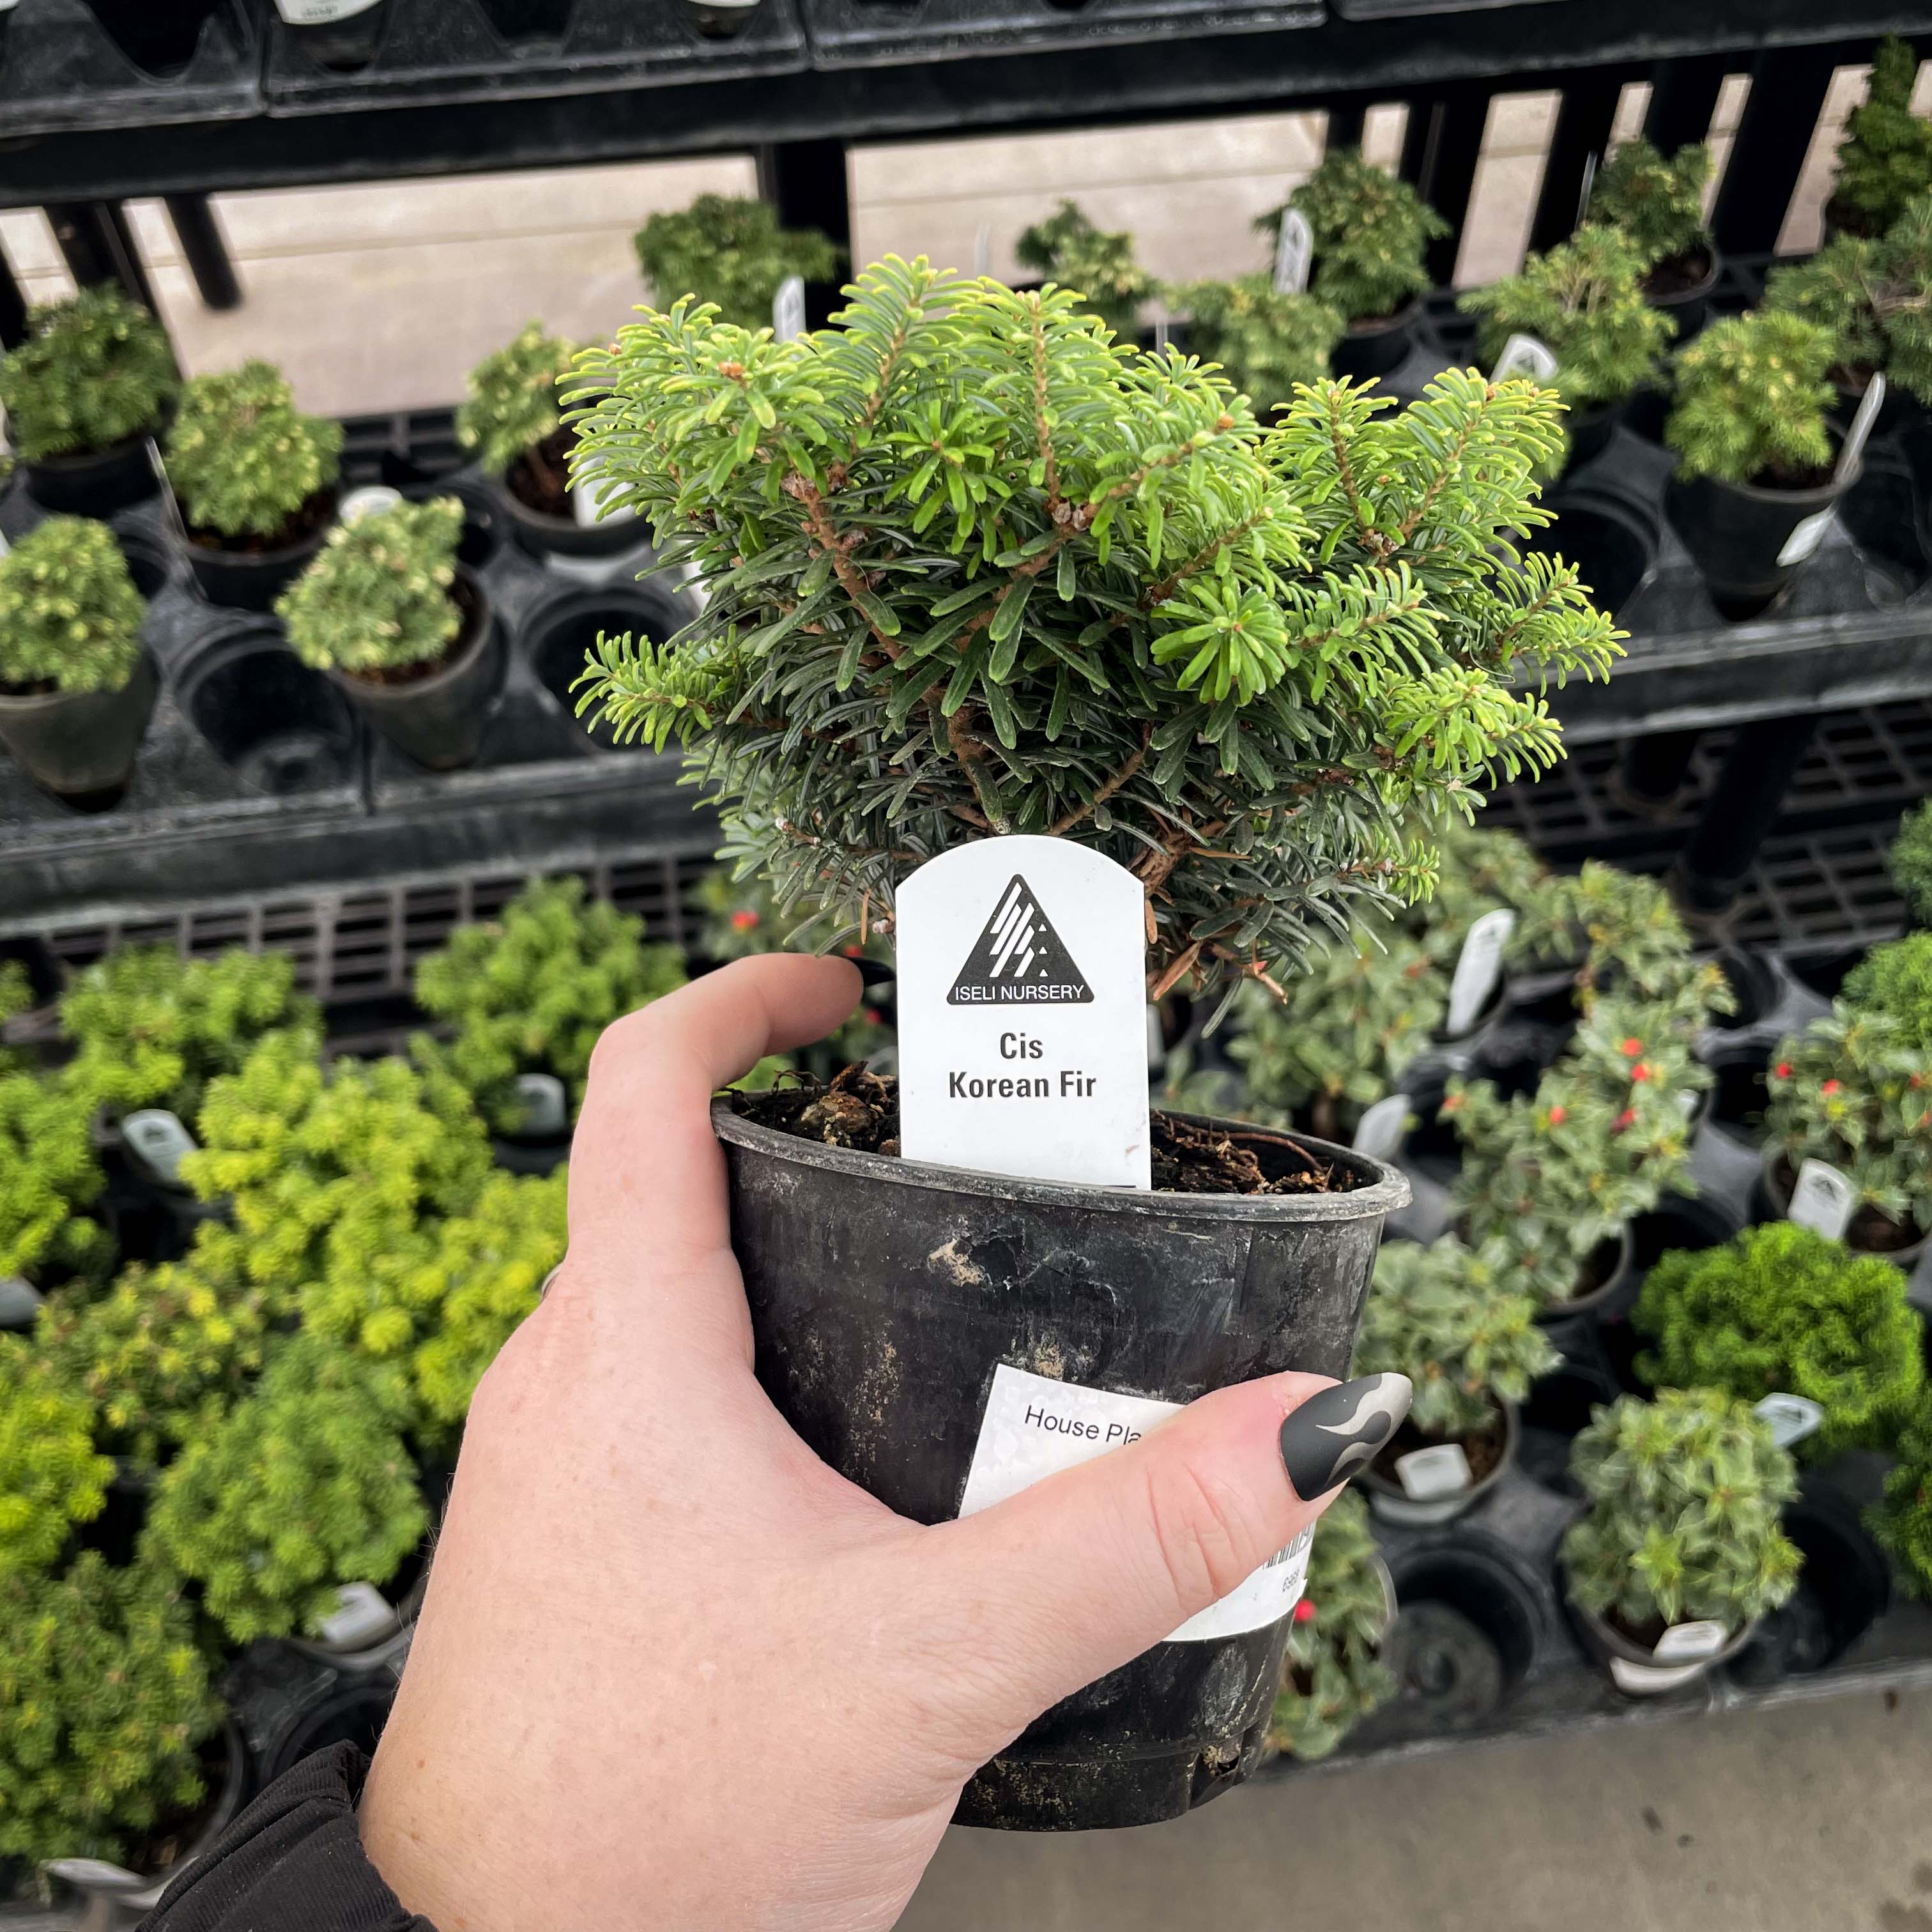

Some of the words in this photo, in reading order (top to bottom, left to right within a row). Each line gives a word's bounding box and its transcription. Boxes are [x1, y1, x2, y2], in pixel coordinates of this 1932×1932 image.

[955, 986, 995, 1001] ISELI
[1001, 985, 1084, 1000] NURSERY
[1000, 1032, 1043, 1059] Cis
[949, 1071, 1049, 1098] Korean
[1060, 1070, 1096, 1097] Fir
[1025, 1405, 1100, 1439] House
